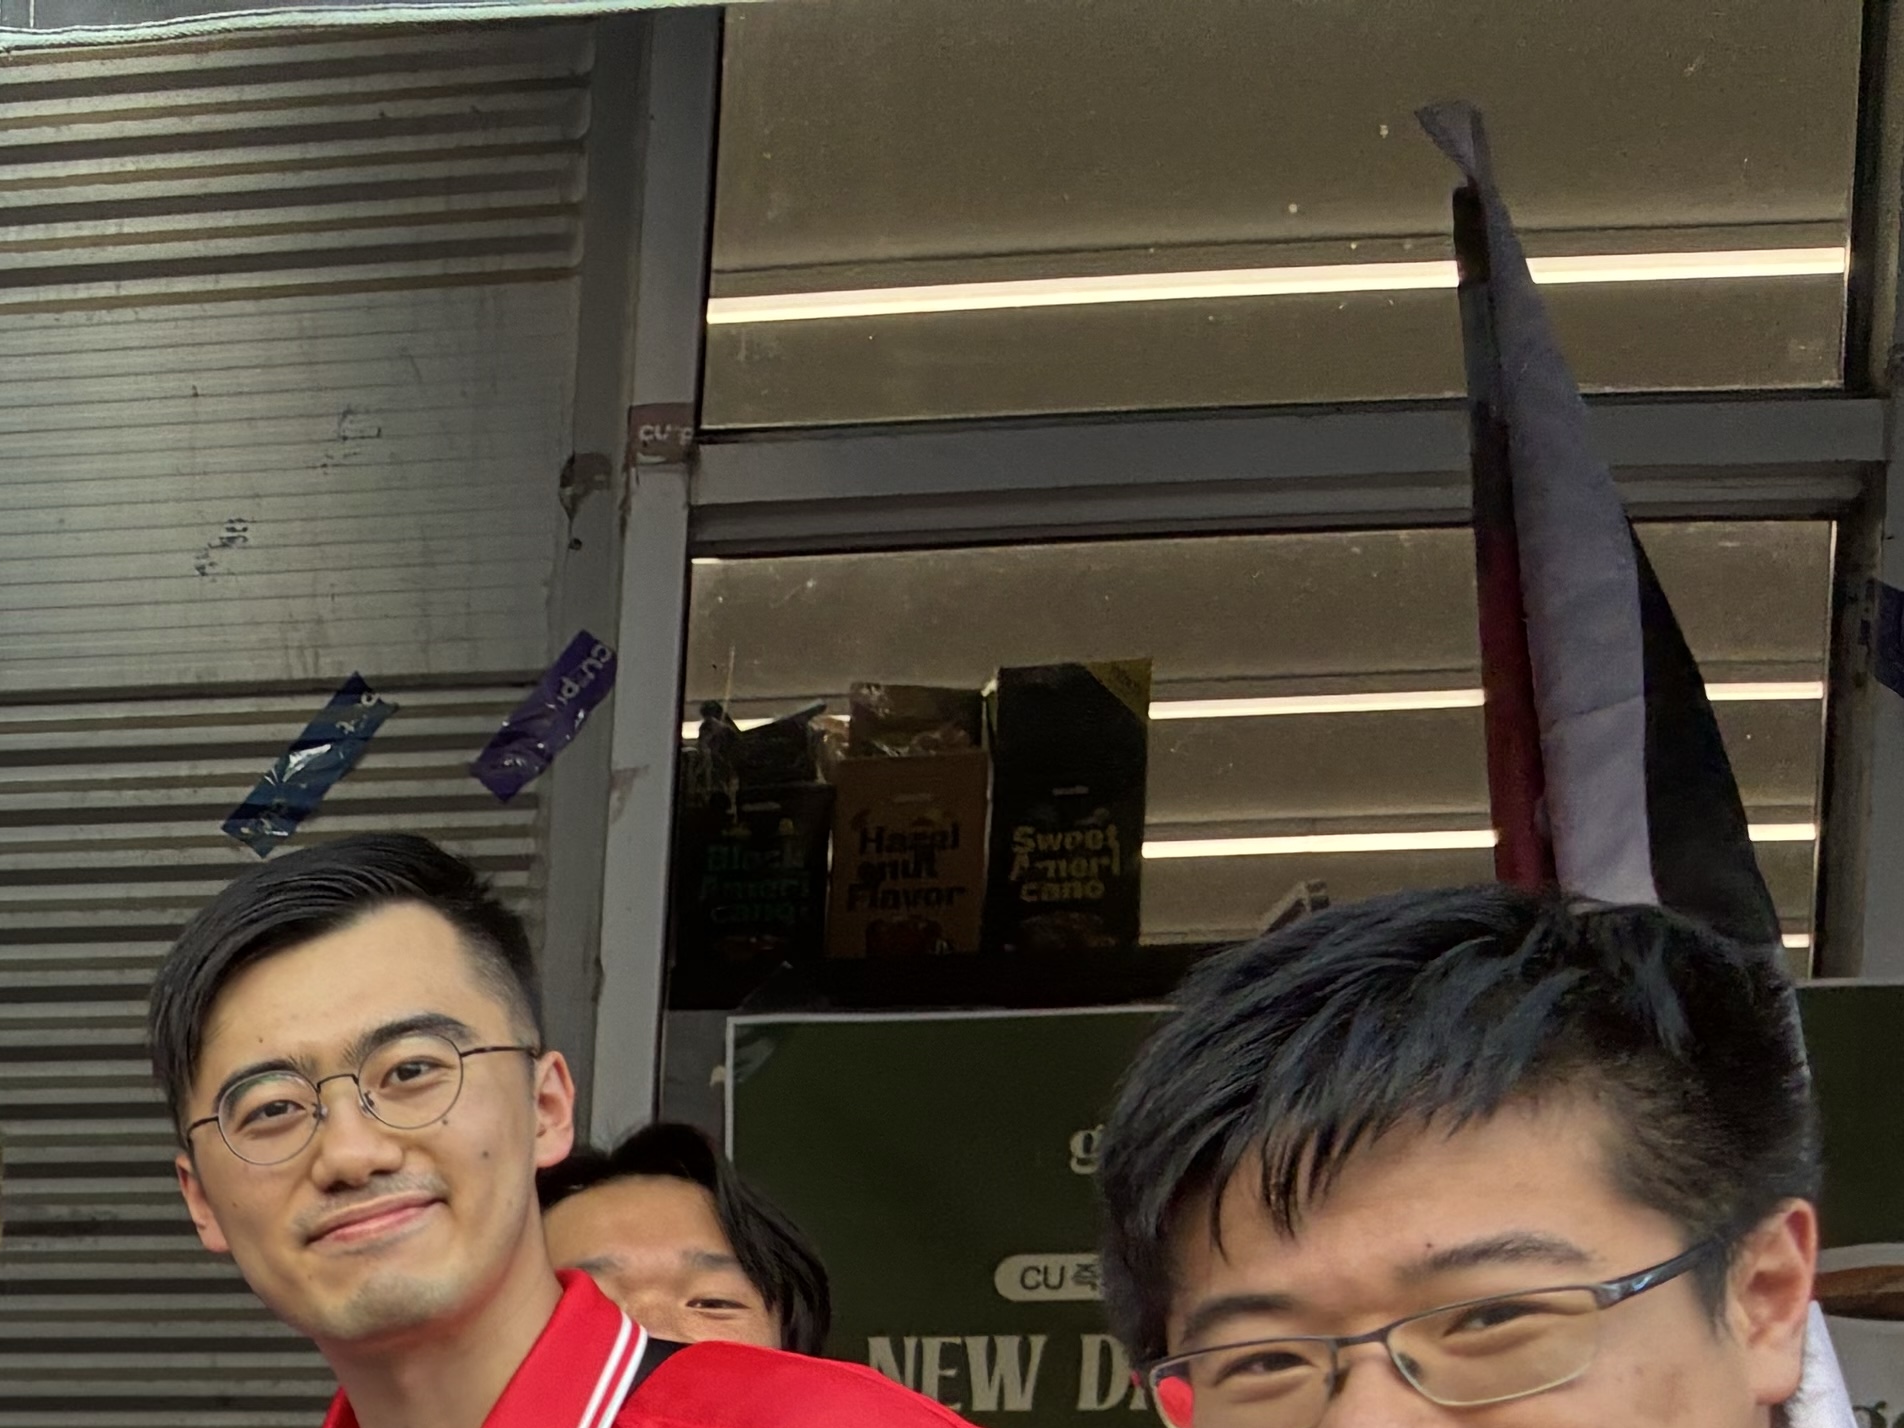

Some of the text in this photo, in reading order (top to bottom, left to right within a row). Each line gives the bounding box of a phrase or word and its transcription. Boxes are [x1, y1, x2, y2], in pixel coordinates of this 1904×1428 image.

[1020, 1264, 1067, 1292] CU
[866, 1332, 1151, 1413] NEW D
